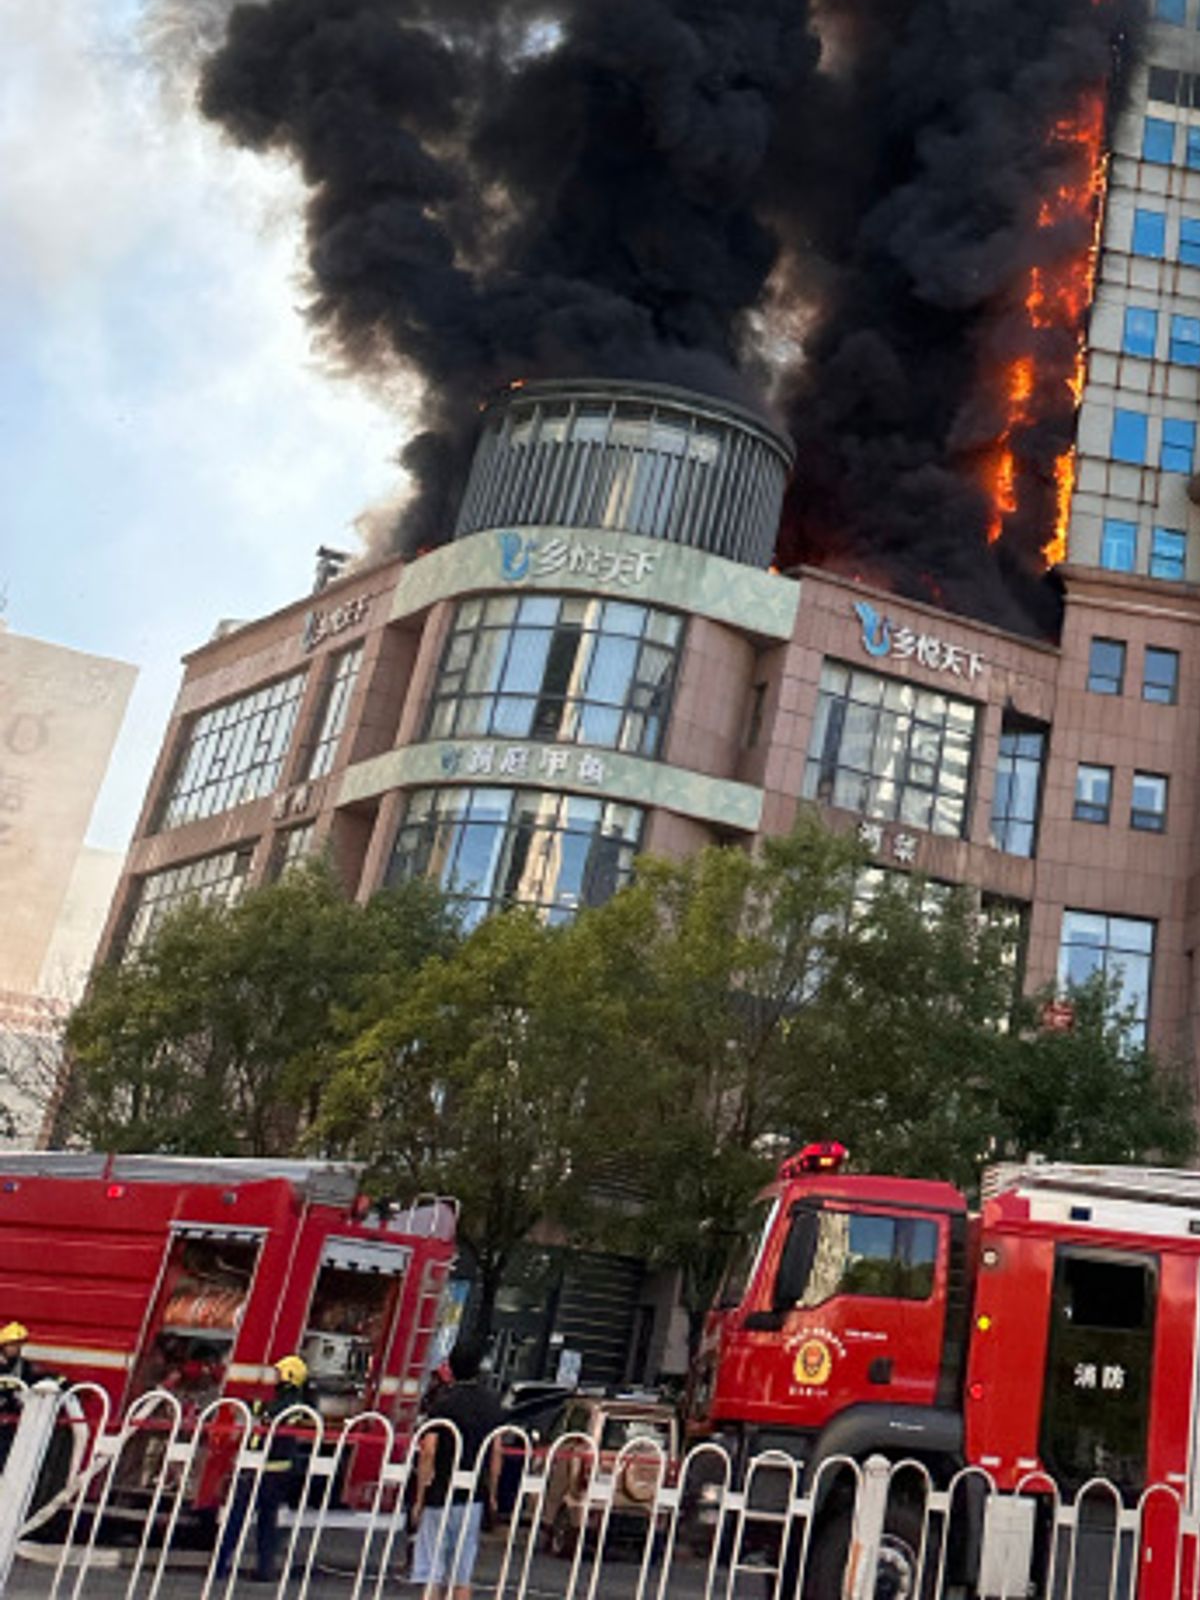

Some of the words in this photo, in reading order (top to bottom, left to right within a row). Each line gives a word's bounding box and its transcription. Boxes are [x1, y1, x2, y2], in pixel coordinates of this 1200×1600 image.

[891, 627, 985, 679] 乡悦天下
[1074, 1363, 1125, 1390] 消防
